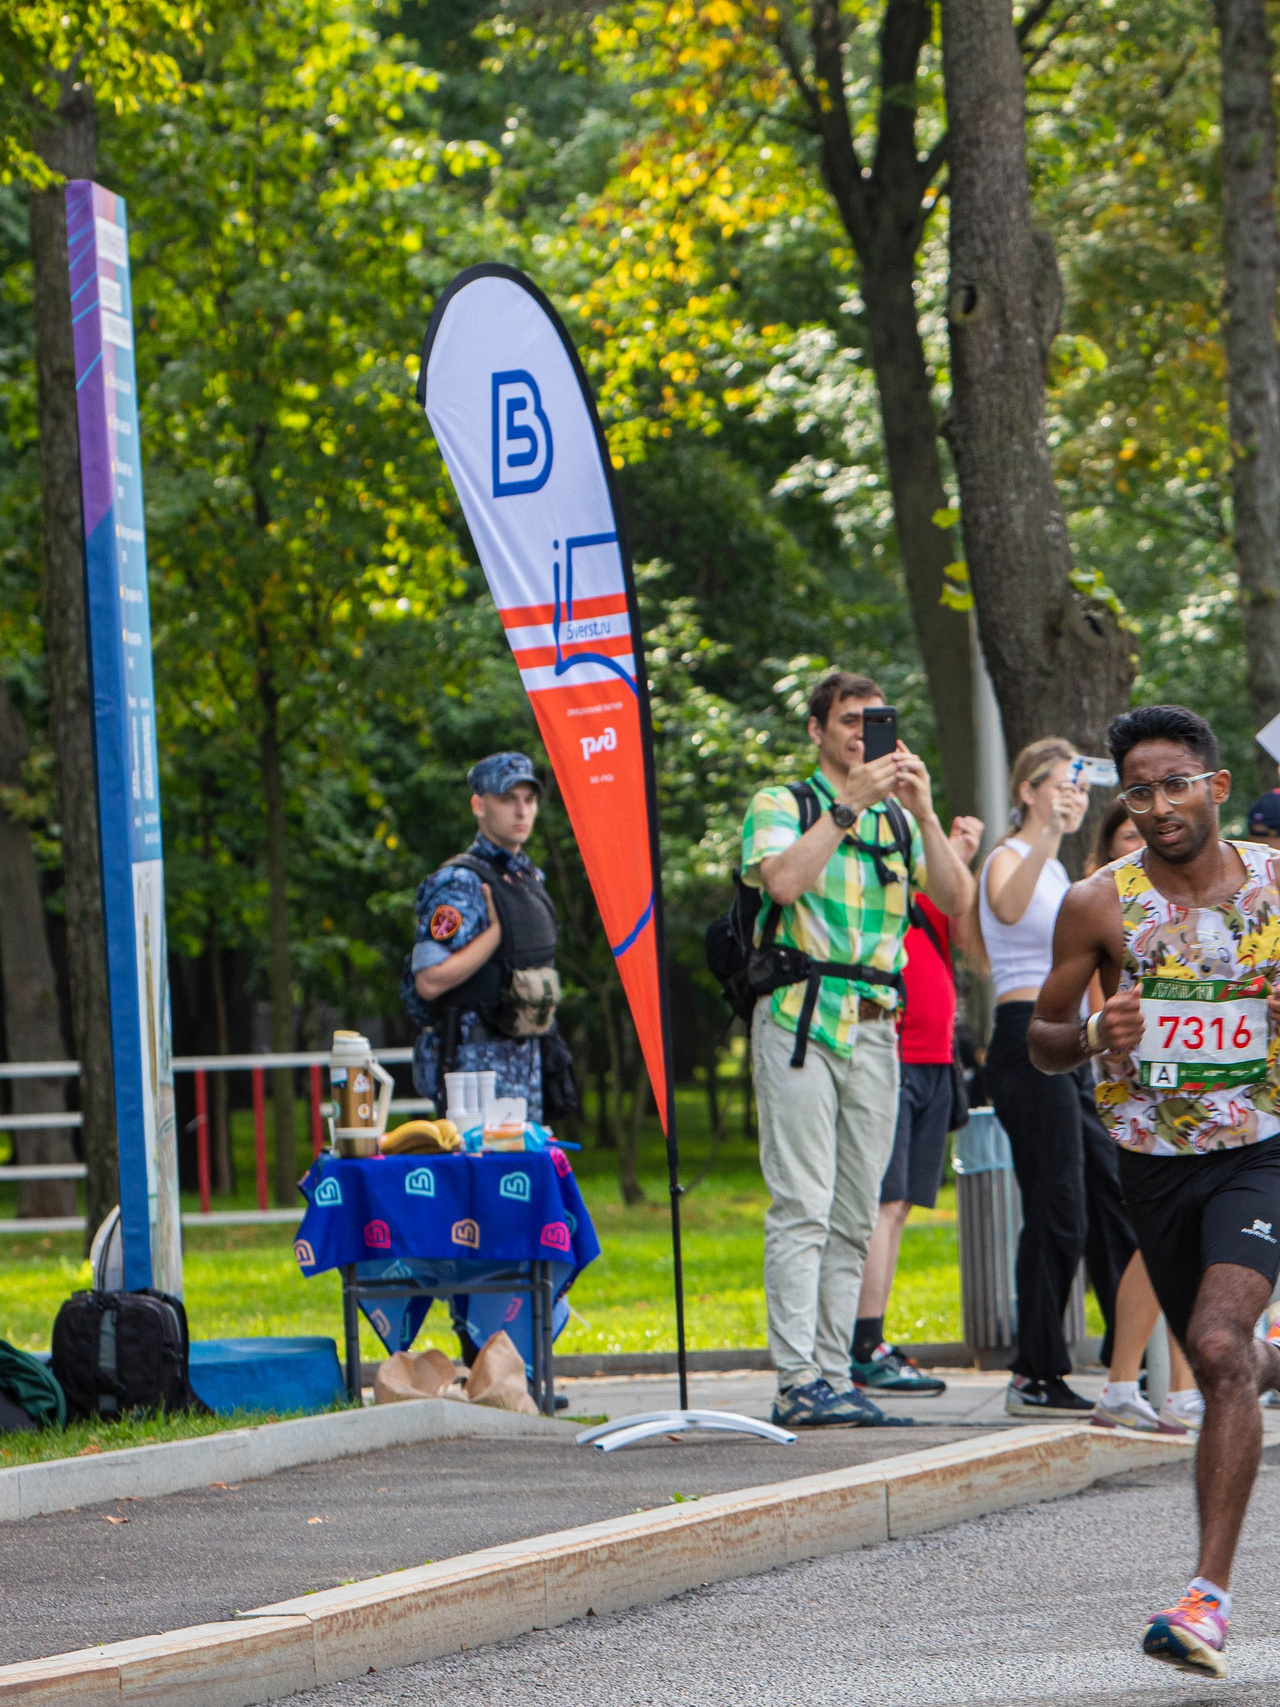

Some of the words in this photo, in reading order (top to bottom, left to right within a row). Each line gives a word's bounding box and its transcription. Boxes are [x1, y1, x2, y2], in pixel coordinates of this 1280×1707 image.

[566, 620, 611, 641] 5verst.ru
[1157, 1015, 1252, 1050] 7316
[1155, 1066, 1172, 1084] A
